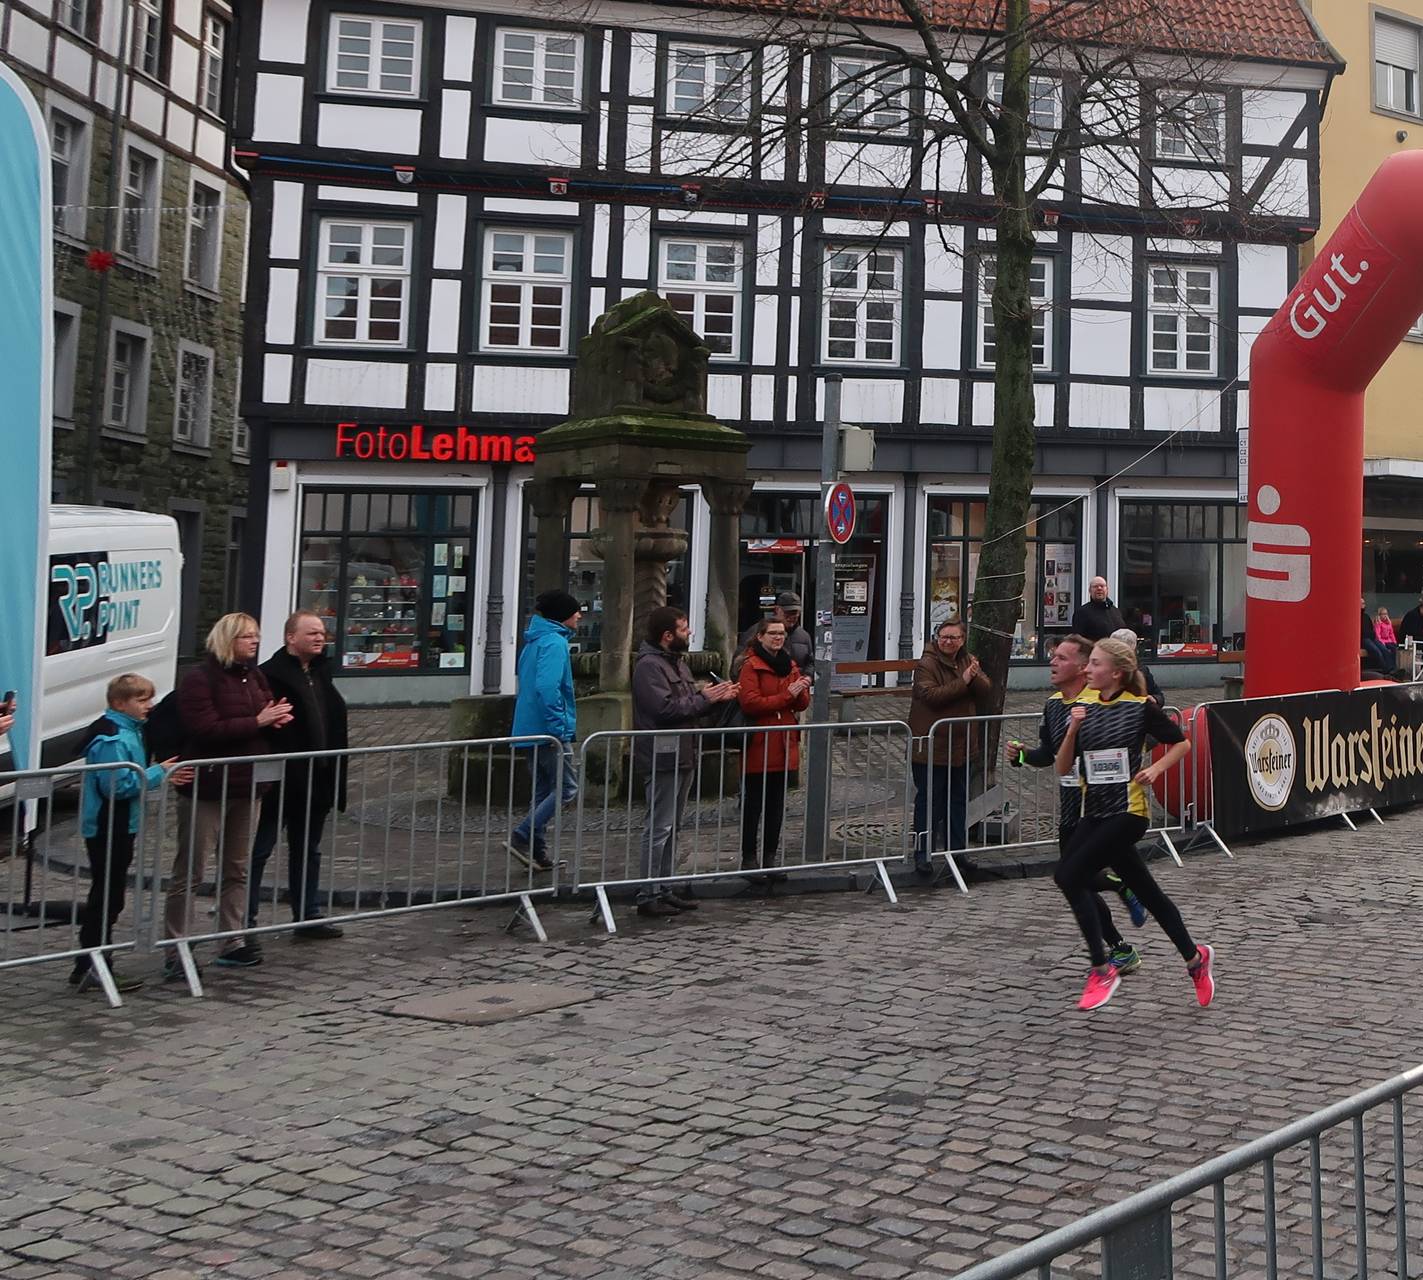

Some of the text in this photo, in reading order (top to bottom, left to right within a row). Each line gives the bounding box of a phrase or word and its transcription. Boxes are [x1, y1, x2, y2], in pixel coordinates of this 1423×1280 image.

[1290, 252, 1369, 339] Gut.
[97, 560, 162, 594] RUNNERS
[97, 599, 140, 637] POINT
[1248, 748, 1291, 774] Warsteiner
